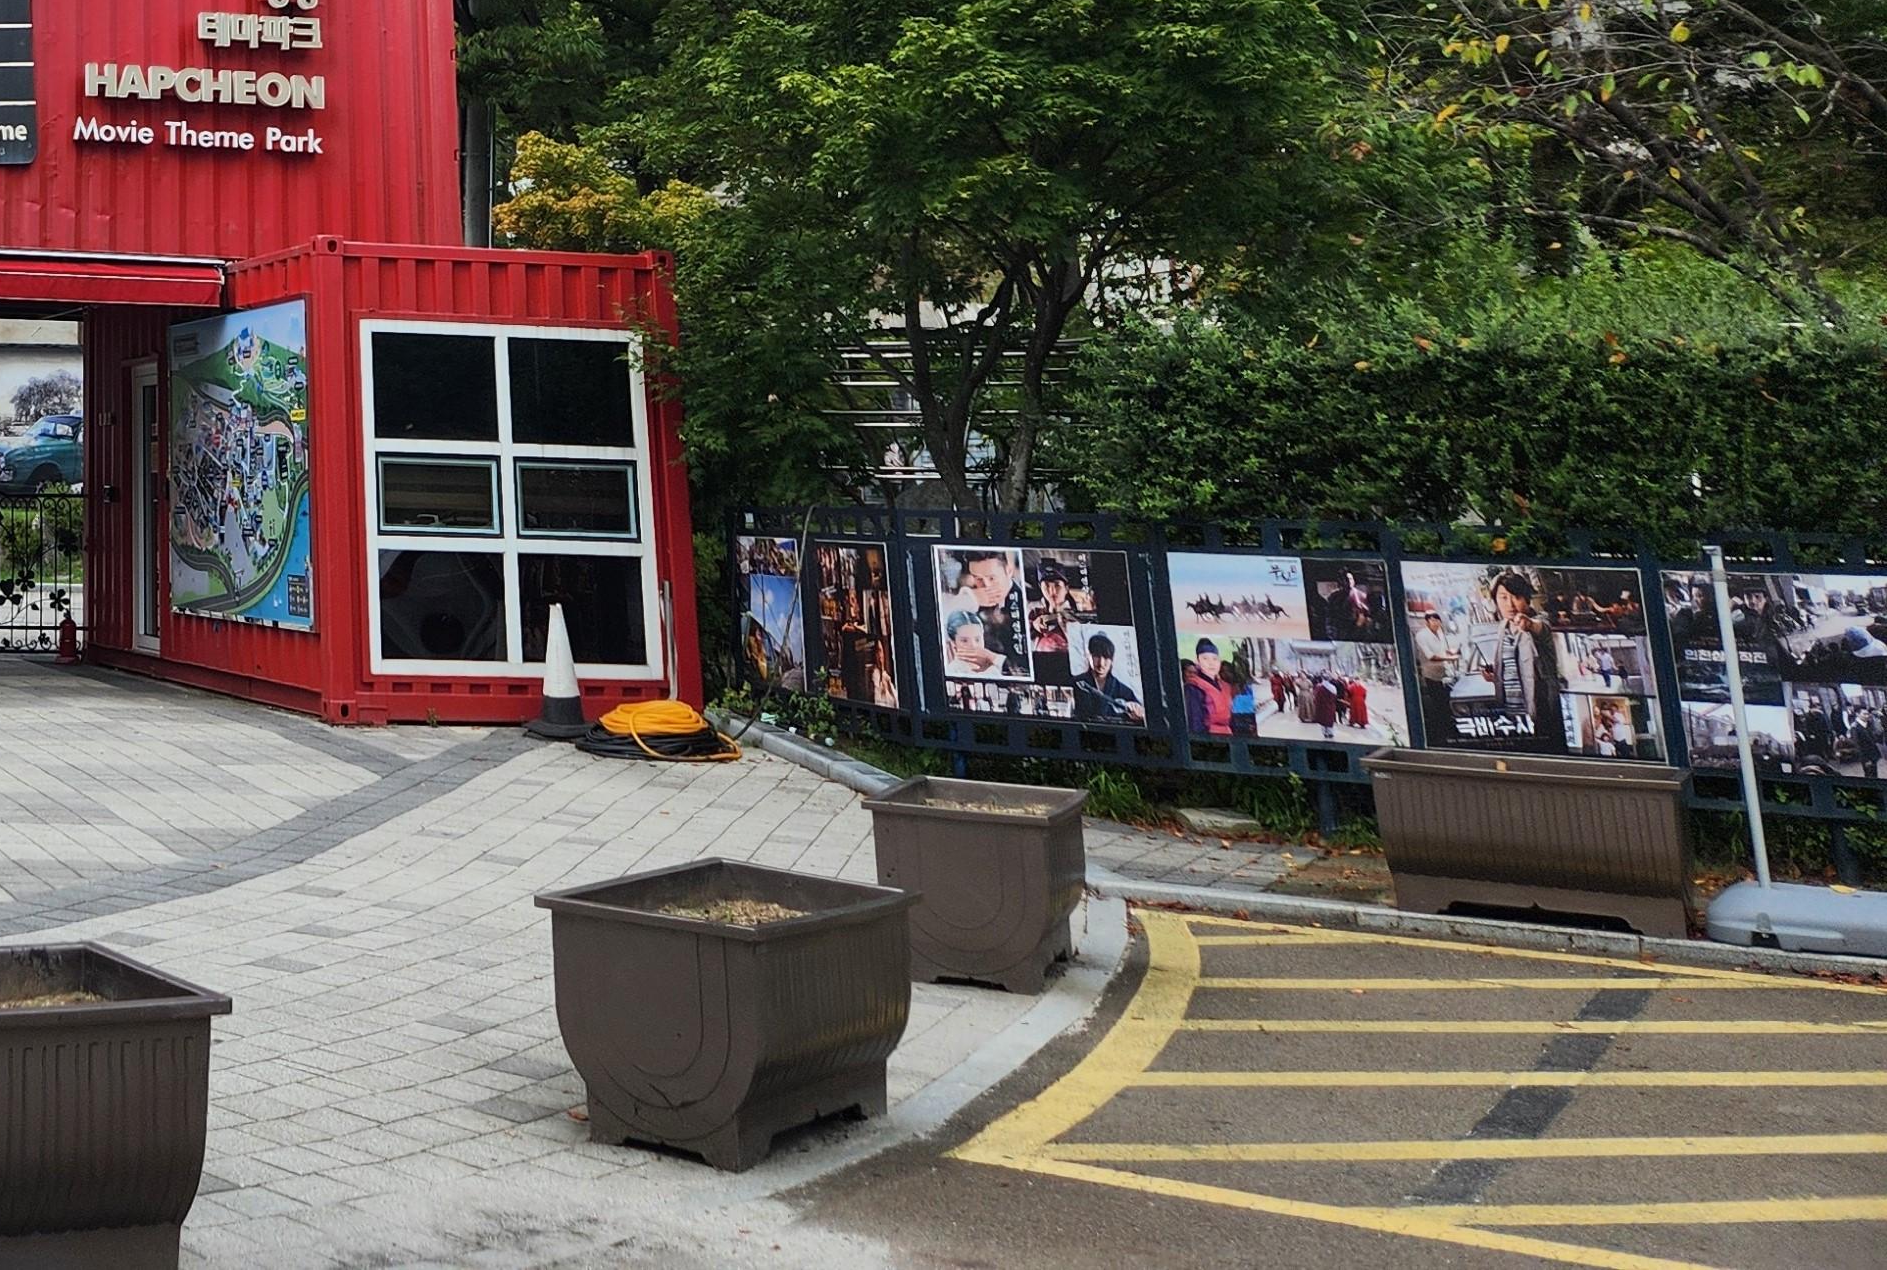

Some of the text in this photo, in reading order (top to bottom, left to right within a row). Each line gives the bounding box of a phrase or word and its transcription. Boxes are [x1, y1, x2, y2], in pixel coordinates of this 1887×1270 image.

[197, 12, 323, 50] 테마파크
[84, 62, 325, 109] HAPCHEON
[73, 116, 323, 154] Movie Theme Park
[1684, 649, 1769, 664] 인천상작전
[1455, 714, 1535, 737] 극비수사
